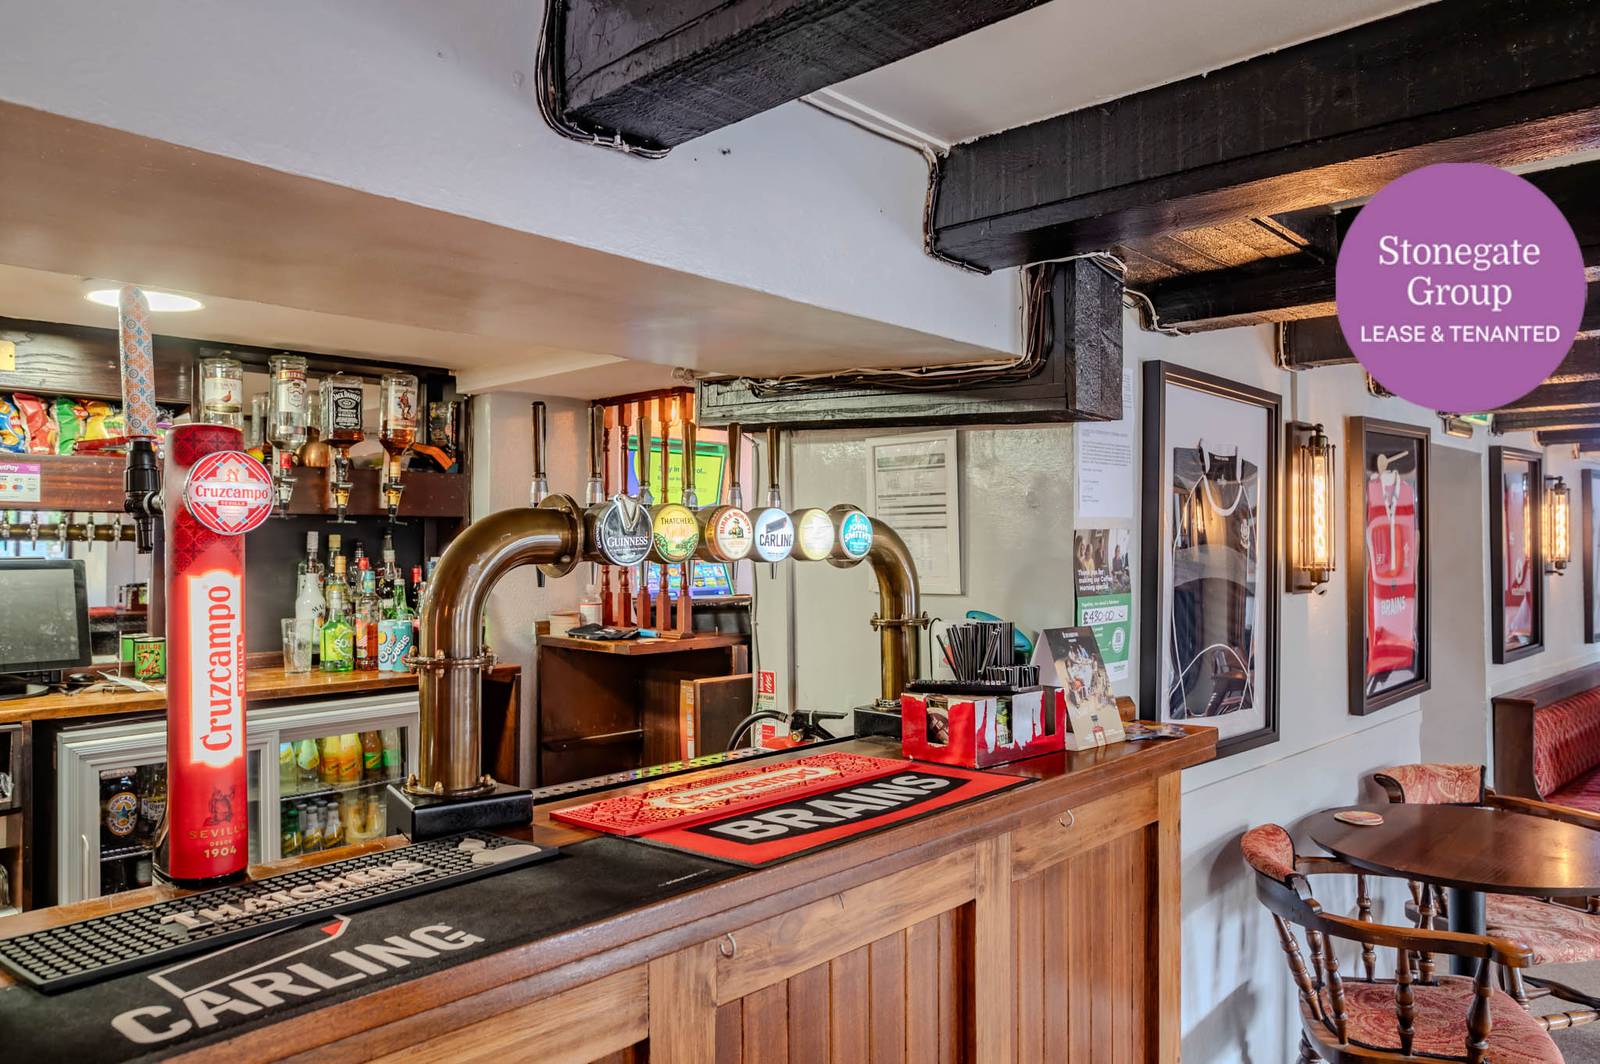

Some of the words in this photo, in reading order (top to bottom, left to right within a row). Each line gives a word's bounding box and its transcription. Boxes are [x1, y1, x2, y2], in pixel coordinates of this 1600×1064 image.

[195, 484, 268, 501] Cruzcampo
[660, 516, 695, 525] THATCHERS
[607, 535, 648, 548] GUINNESS
[1380, 595, 1406, 616] BRAINS
[201, 586, 236, 752] Cruzcampo
[667, 767, 821, 804] Cruzcampo
[708, 774, 953, 840] BRAINS
[203, 845, 237, 859] 1904
[159, 858, 427, 933] THATCHERS
[111, 923, 486, 1045] CARLING
